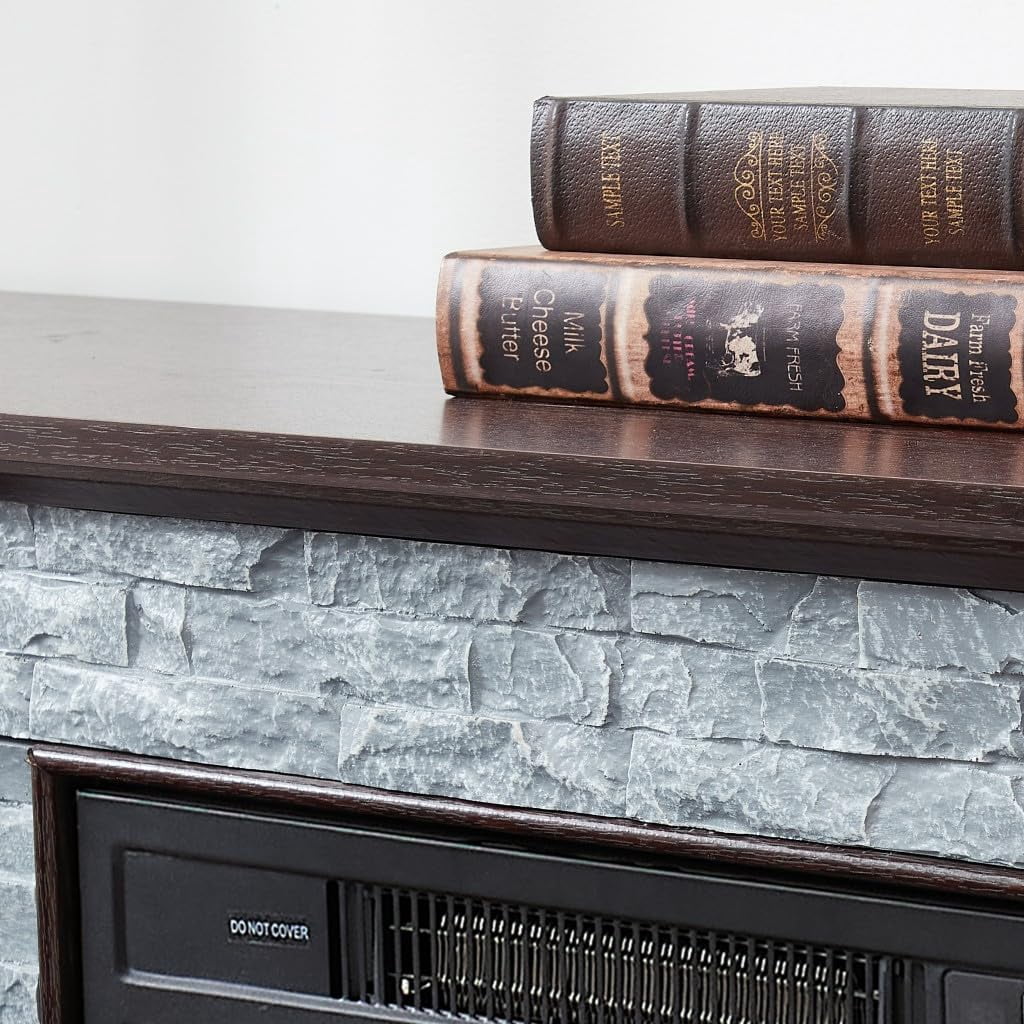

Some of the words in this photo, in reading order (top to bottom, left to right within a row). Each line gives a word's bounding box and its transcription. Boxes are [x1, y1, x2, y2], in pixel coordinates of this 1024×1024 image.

[601, 132, 621, 168] TEXT
[768, 131, 784, 167] HERE
[790, 144, 806, 178] TEXT
[920, 138, 938, 171] HERE
[945, 148, 963, 181] TEXT
[602, 172, 625, 228] SAMPLE
[768, 169, 784, 203] TEXT
[790, 180, 809, 232] SAMPLE
[921, 173, 938, 206] TEXT
[769, 206, 788, 241] YOUR
[922, 210, 941, 245] YOUR
[945, 185, 966, 236] SAMPLE
[500, 296, 523, 361] Butter
[531, 288, 555, 373] Cheese
[563, 311, 586, 354] Milk
[785, 303, 803, 343] FARM
[968, 313, 991, 355] Farm
[785, 346, 803, 391] FRESH
[921, 310, 963, 401] DAIRY
[968, 359, 991, 403] Fresh
[230, 919, 247, 935] DO
[247, 921, 270, 937] NOT
[271, 923, 309, 940] COVER
